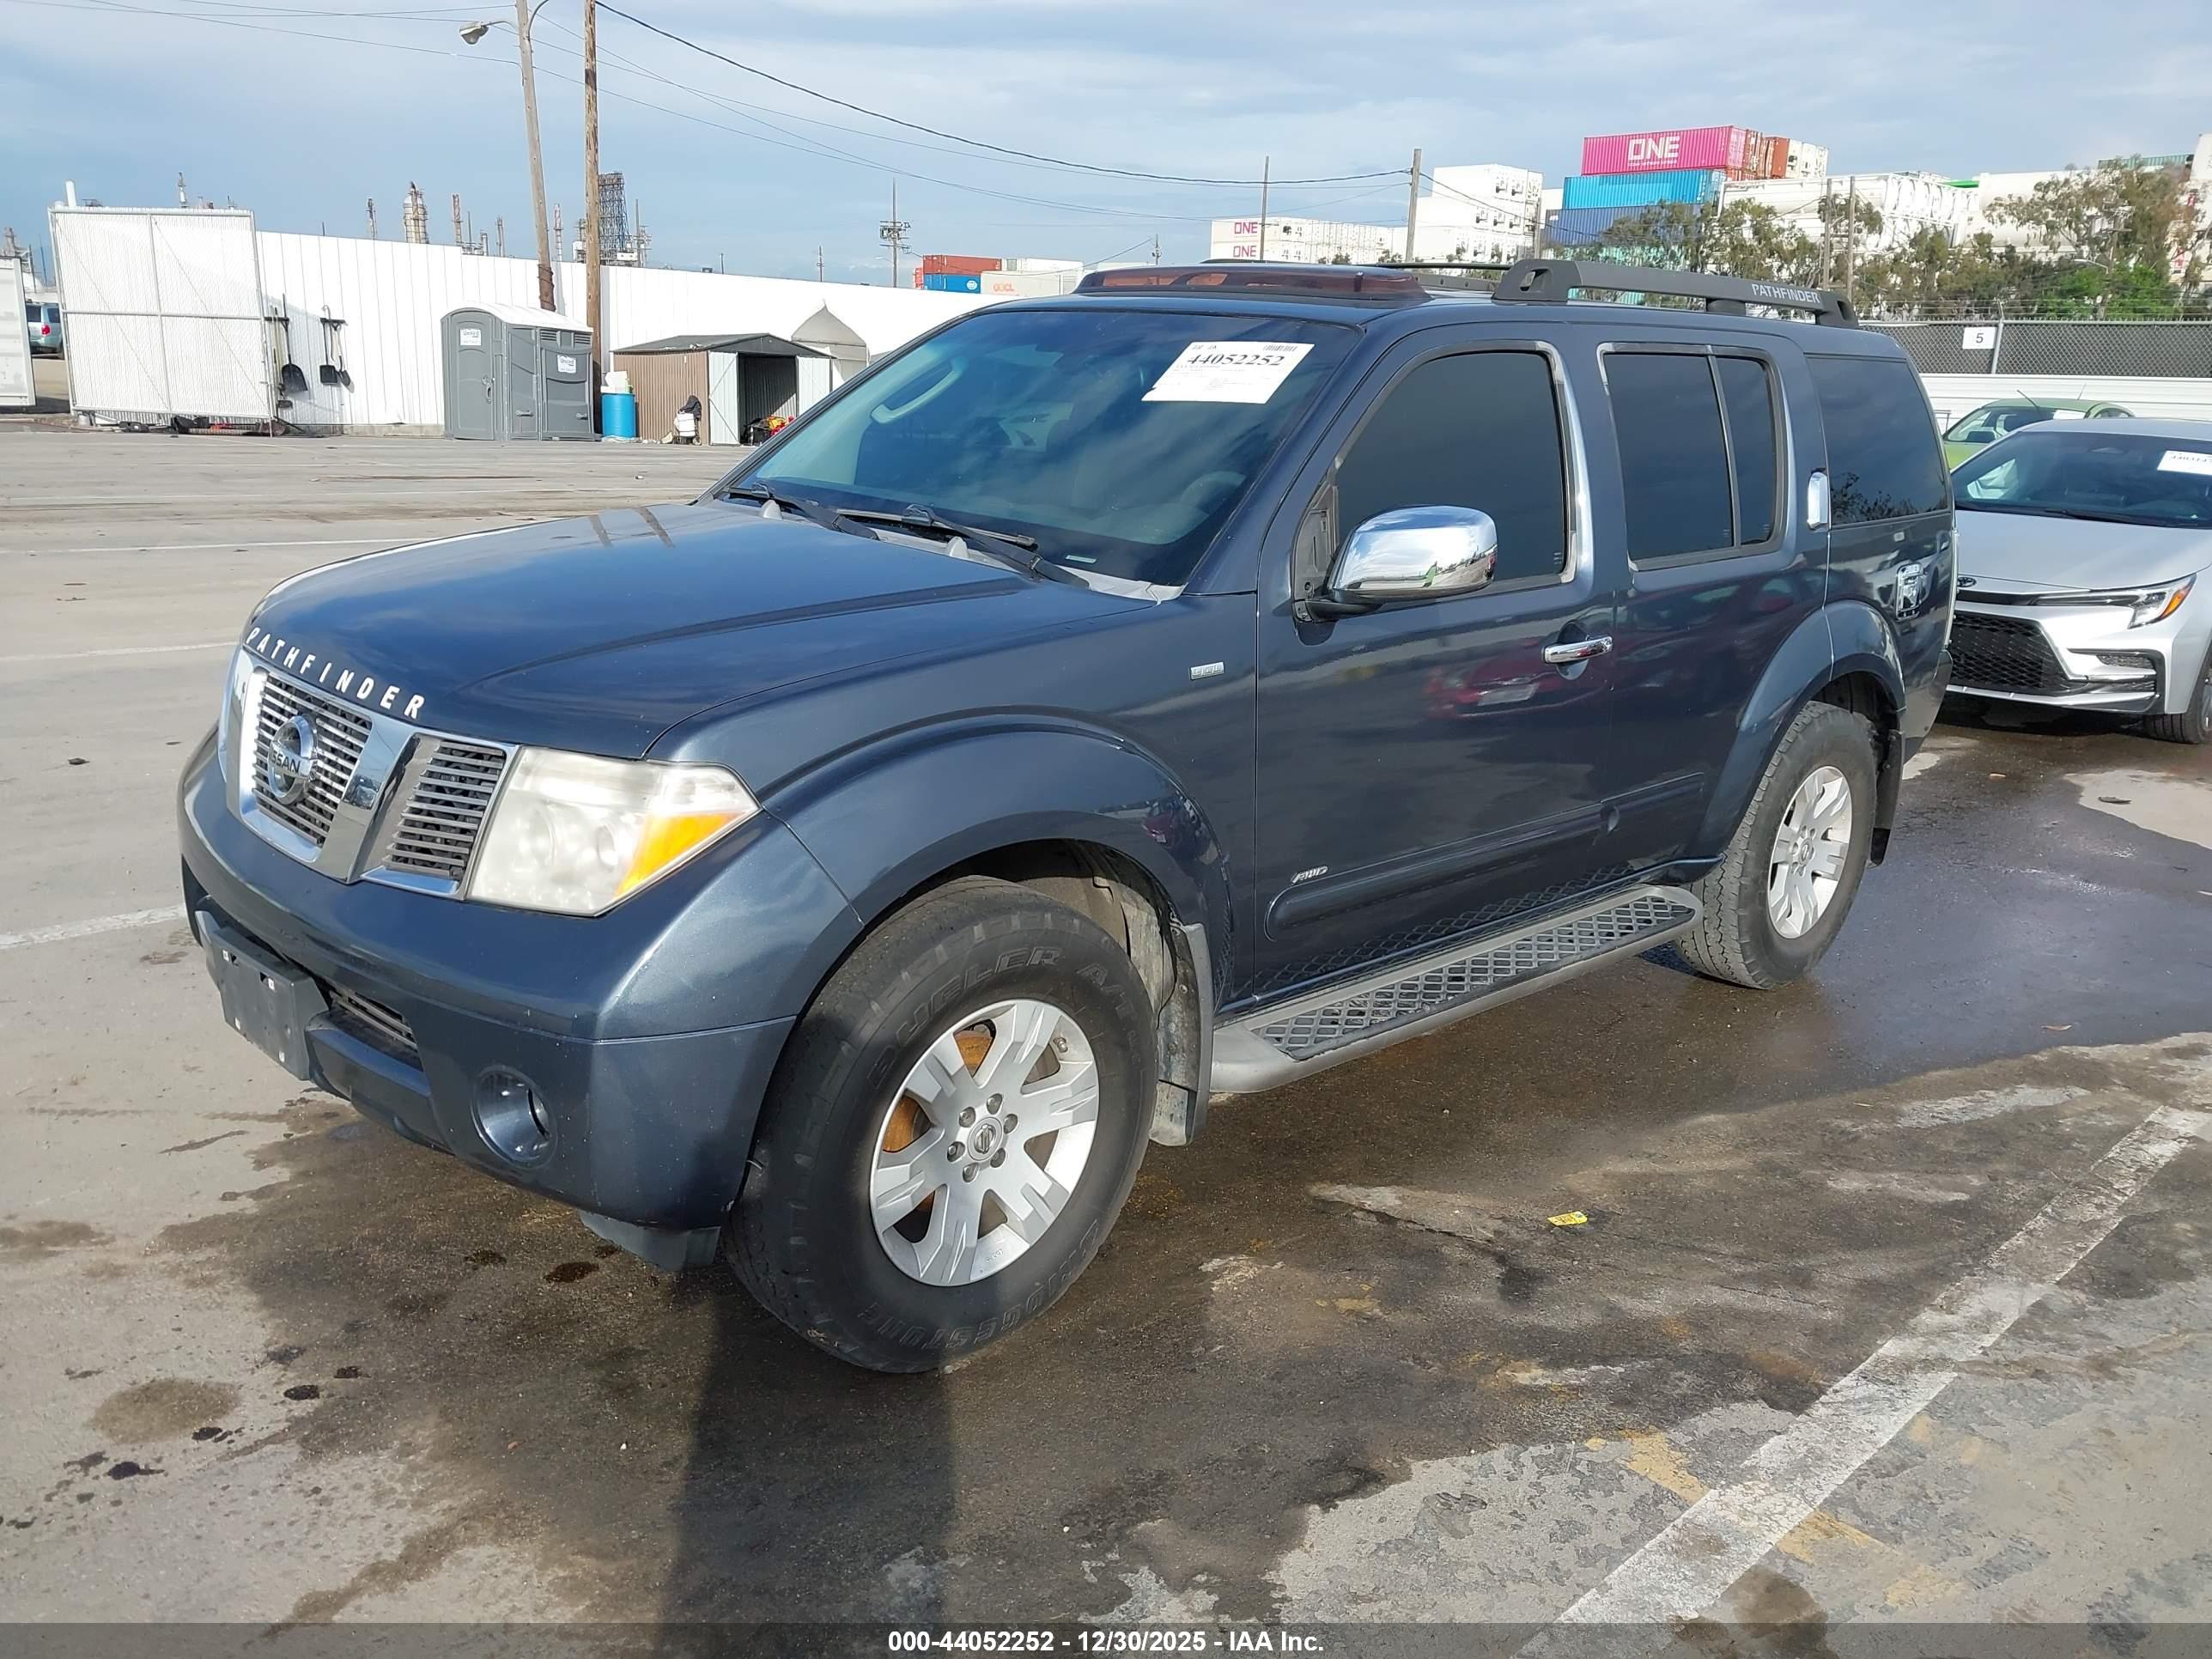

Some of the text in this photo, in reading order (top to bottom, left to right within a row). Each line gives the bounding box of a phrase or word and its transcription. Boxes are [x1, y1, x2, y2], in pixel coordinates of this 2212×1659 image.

[1628, 136, 1680, 161] ONE
[1234, 222, 1258, 234] ONE
[1233, 246, 1257, 258] ONE
[1751, 283, 1821, 304] PATHFINDER
[1976, 332, 1984, 344] 5
[1187, 353, 1285, 367] 44052252
[245, 627, 426, 720] PATHFINDER
